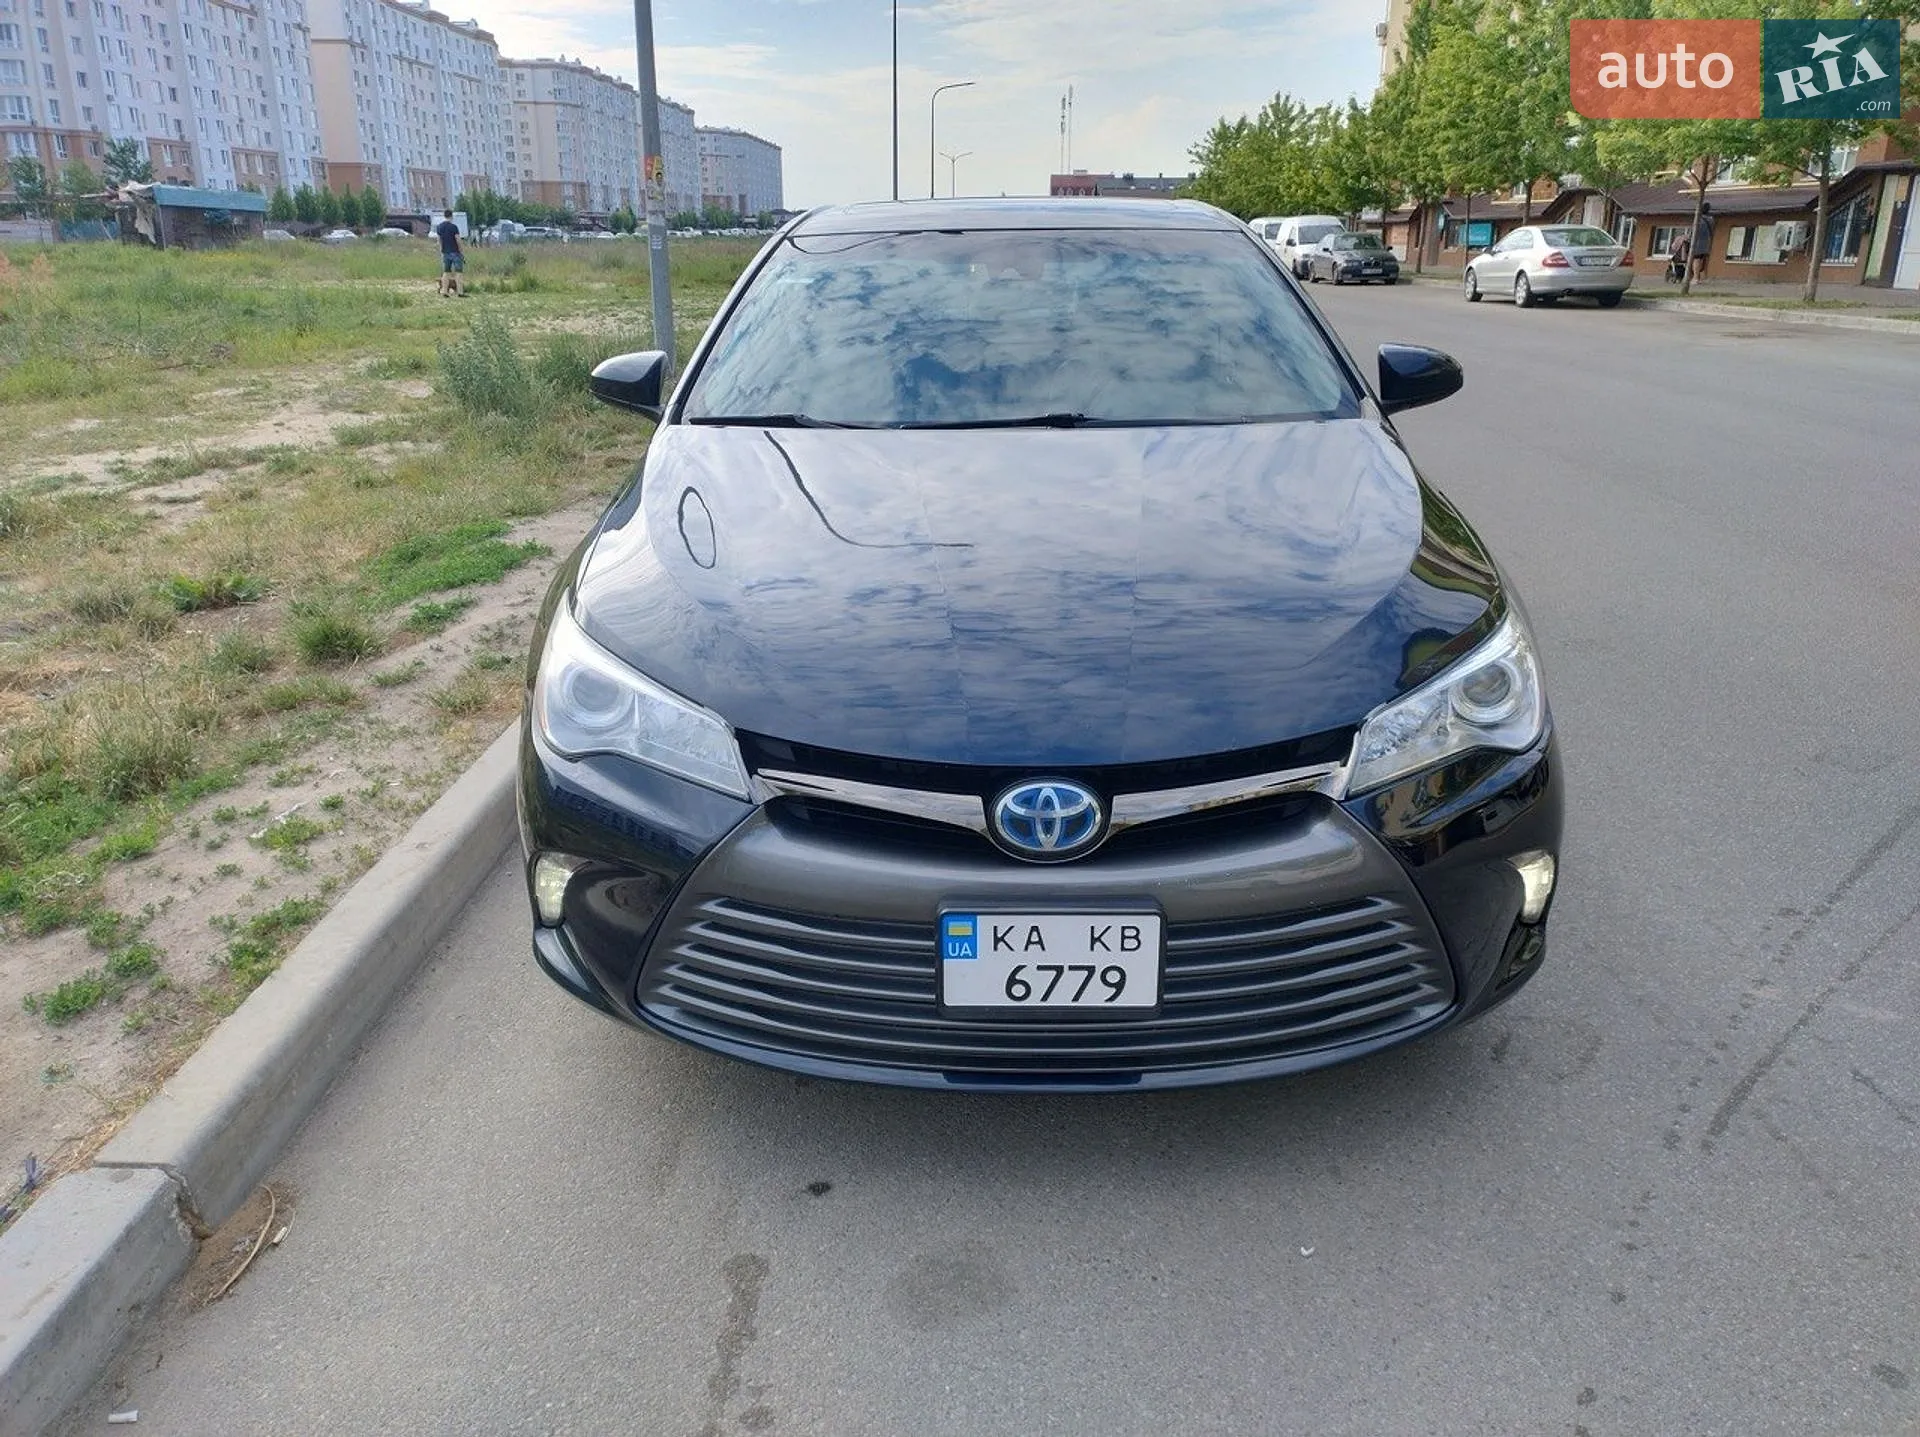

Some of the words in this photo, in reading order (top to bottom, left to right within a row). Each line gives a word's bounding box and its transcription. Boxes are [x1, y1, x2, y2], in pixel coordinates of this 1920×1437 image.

[948, 942, 973, 957] UA
[992, 925, 1046, 952] KA
[1089, 925, 1142, 952] KB
[1005, 964, 1127, 1003] 6779
